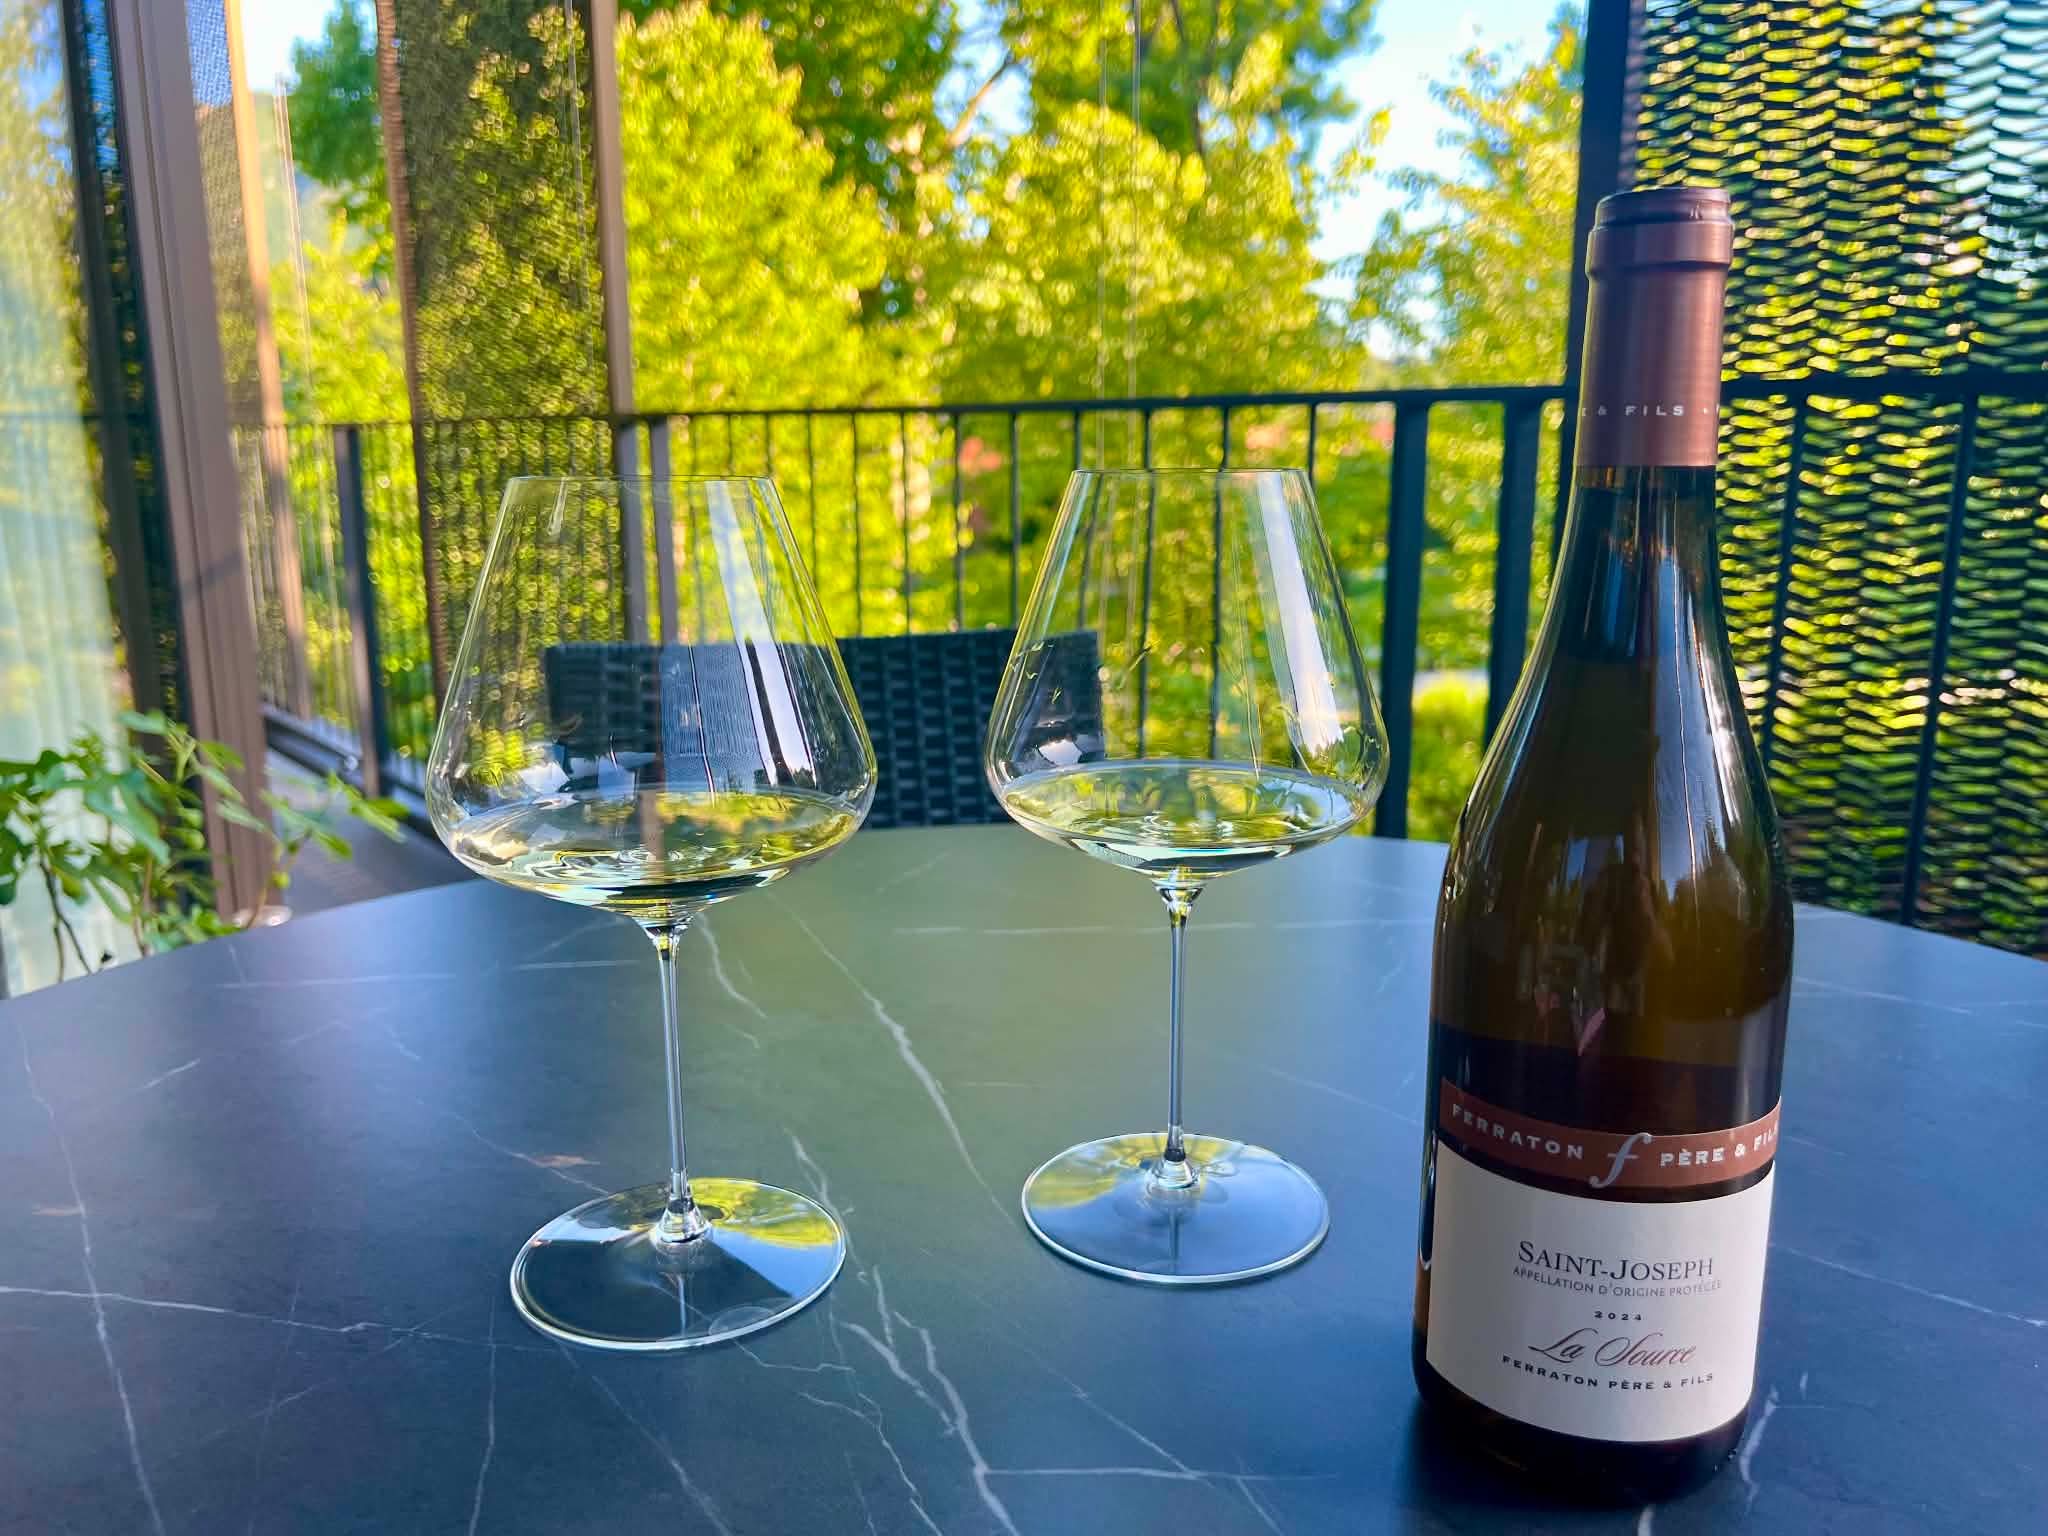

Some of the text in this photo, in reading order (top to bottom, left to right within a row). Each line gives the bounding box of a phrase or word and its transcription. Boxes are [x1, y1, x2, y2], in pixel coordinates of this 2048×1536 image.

[1597, 405, 1608, 416] &
[1625, 405, 1685, 416] FILS
[1452, 1103, 1584, 1160] FERRATON
[1660, 1148, 1725, 1167] PÈRE
[1734, 1143, 1746, 1157] &
[1518, 1240, 1714, 1281] SAINT-JOSEPH
[1513, 1266, 1594, 1294] APPELLATION
[1598, 1281, 1666, 1297] D'ORIGINE
[1593, 1310, 1643, 1321] 2024
[1528, 1327, 1697, 1367] La Source
[1502, 1354, 1714, 1391] FERRATON PÈRE & FILS
